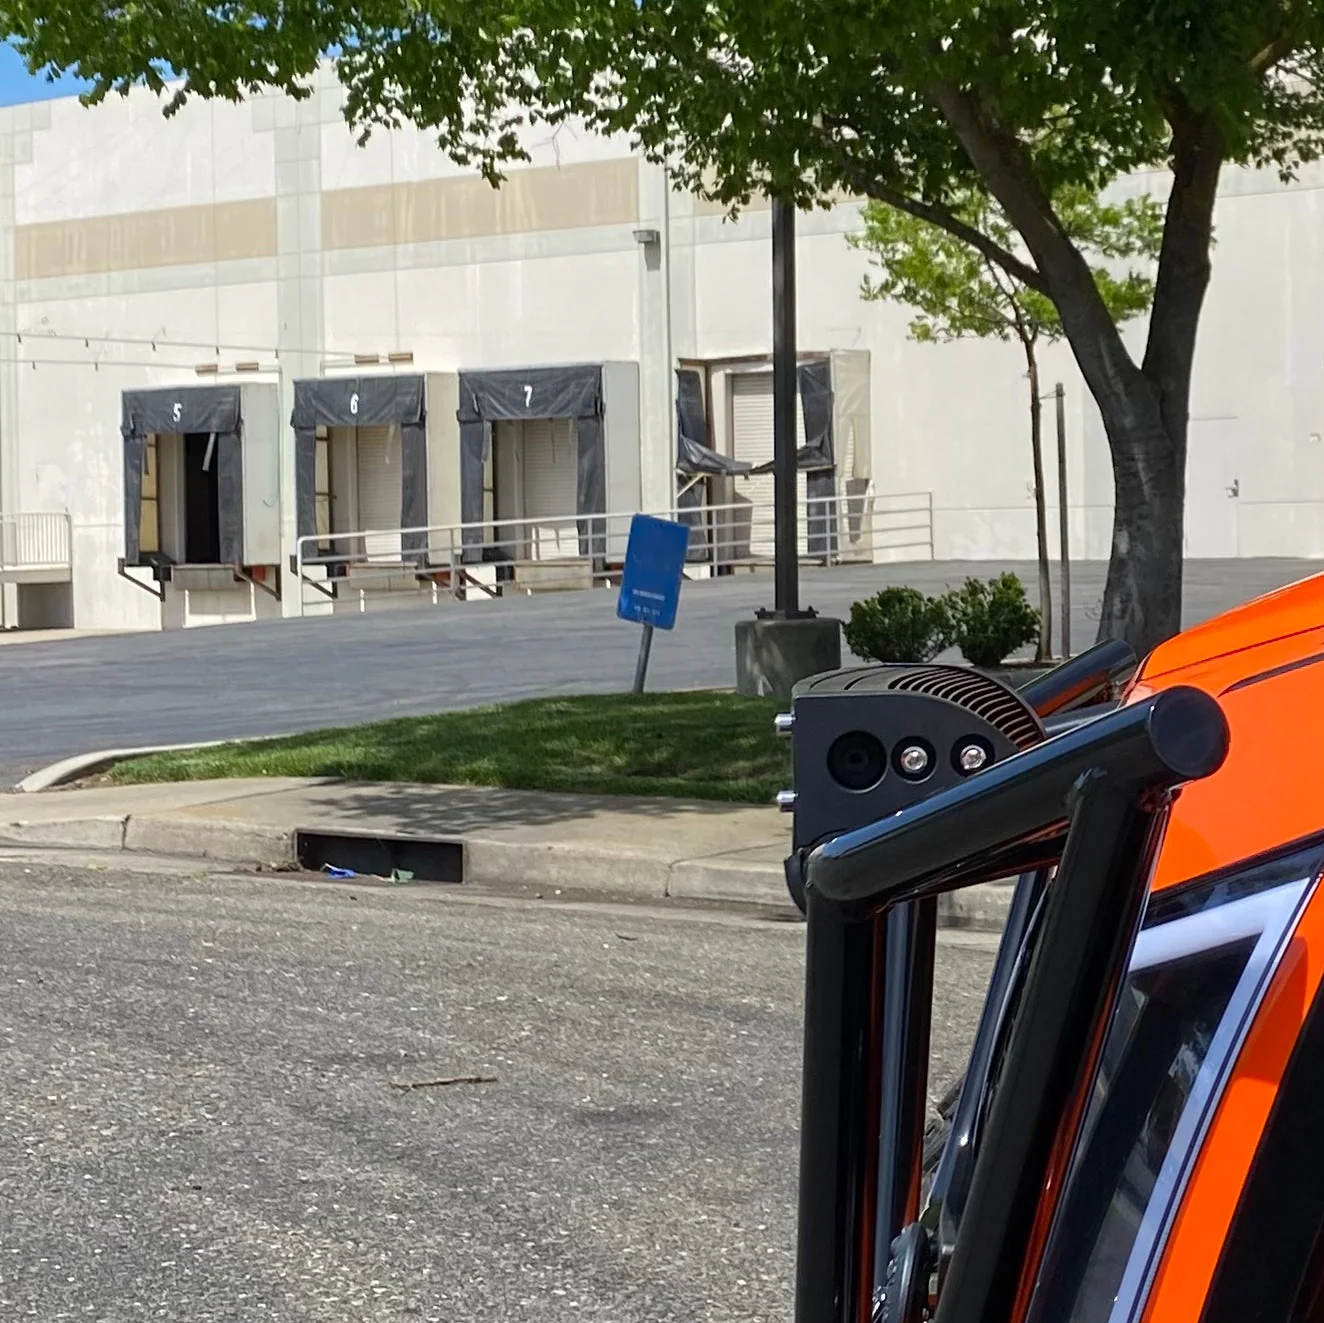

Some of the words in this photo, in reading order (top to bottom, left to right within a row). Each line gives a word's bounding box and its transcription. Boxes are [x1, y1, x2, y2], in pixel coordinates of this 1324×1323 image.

[350, 393, 359, 415] 6
[524, 385, 533, 407] 7
[173, 402, 183, 422] 5
